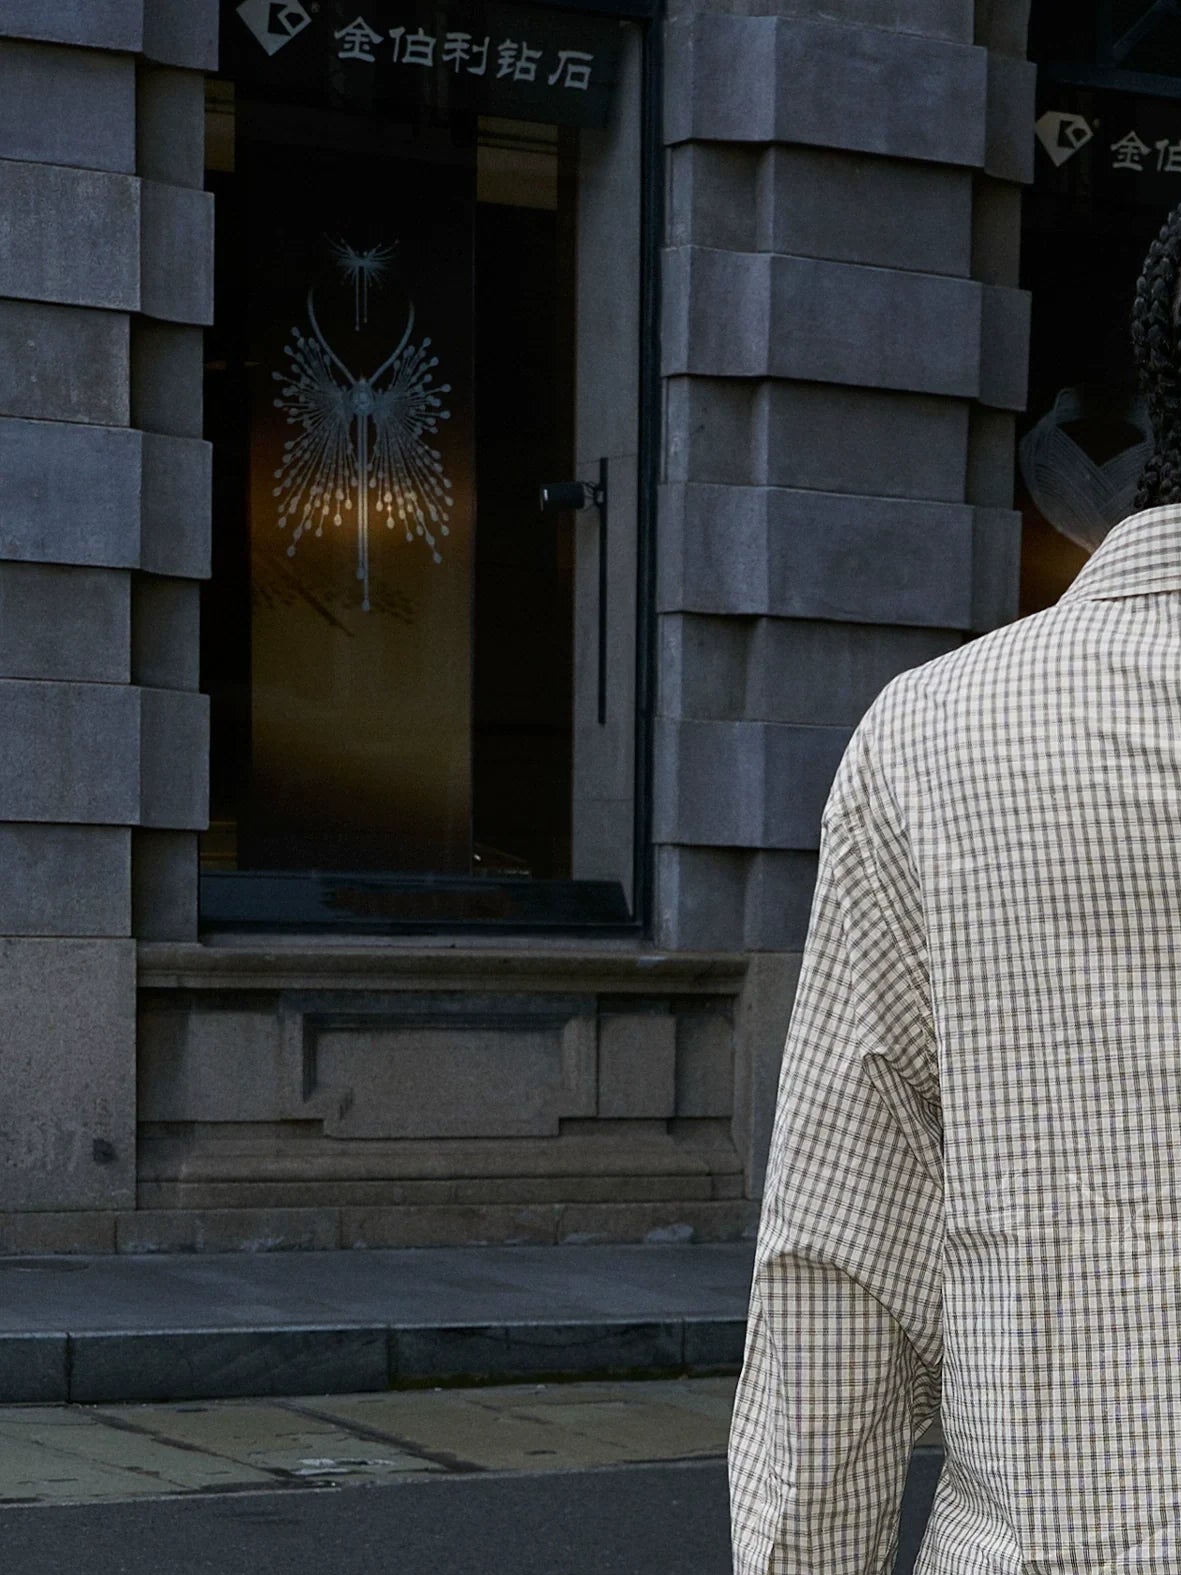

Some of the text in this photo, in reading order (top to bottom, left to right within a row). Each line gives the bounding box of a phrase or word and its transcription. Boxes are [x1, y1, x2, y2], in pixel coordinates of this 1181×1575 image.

[334, 16, 594, 91] 金伯利钻石
